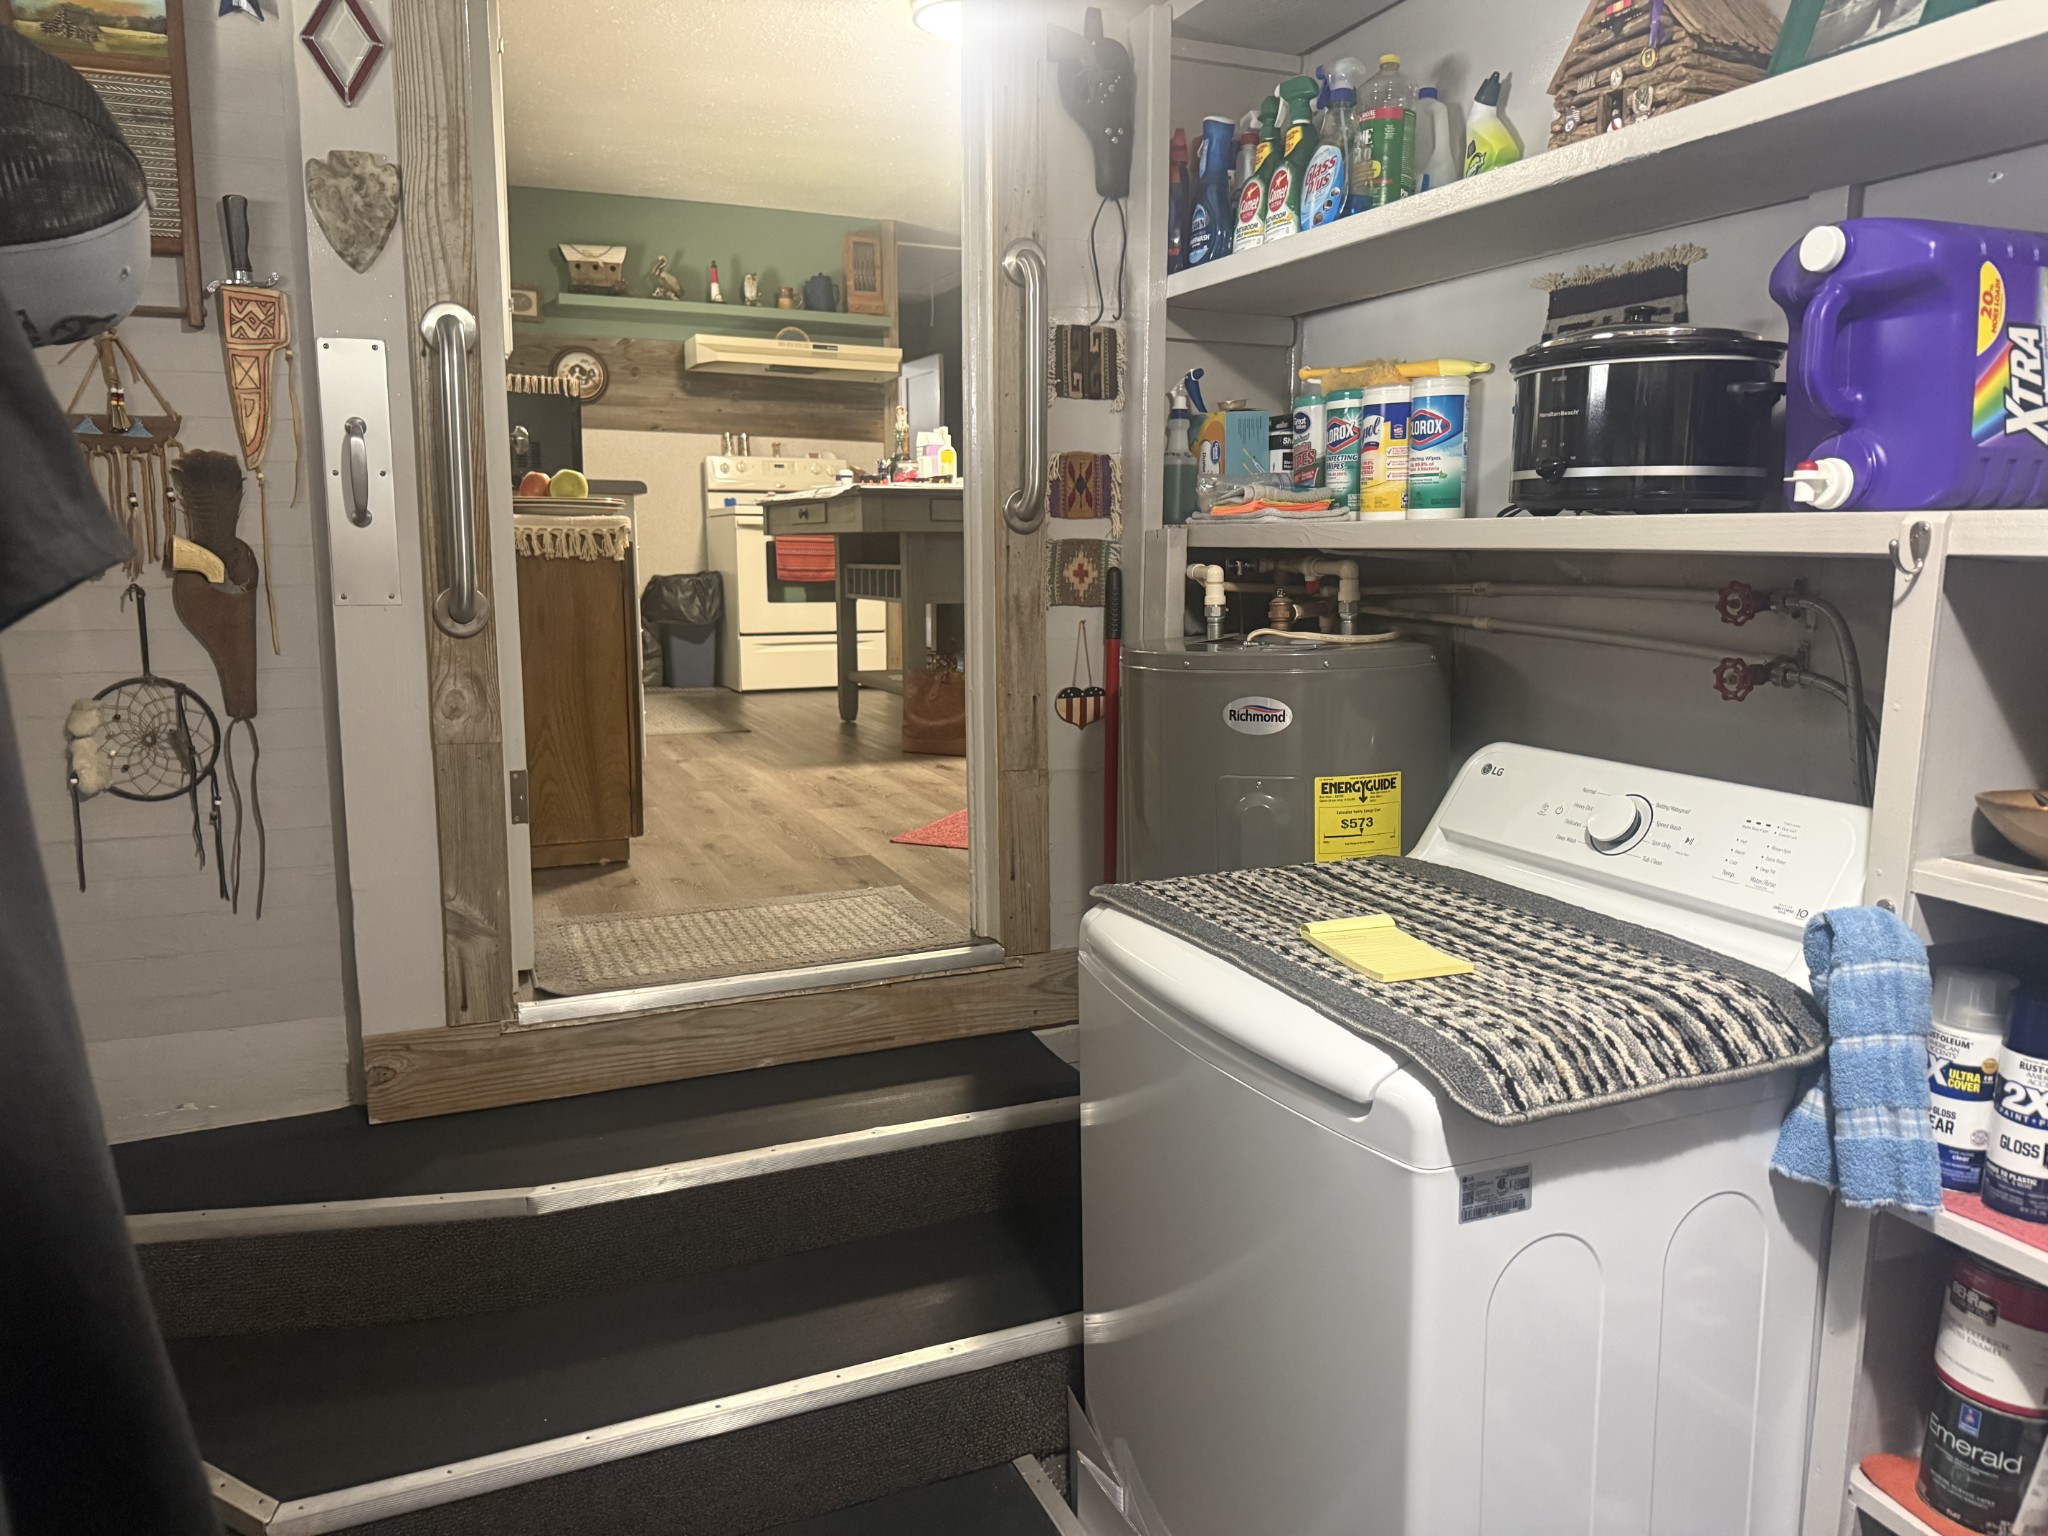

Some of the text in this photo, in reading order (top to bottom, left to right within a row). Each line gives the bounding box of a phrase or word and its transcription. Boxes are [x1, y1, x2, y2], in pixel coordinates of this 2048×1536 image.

[1305, 155, 1338, 187] Glass
[1270, 185, 1288, 202] Comet
[1241, 197, 1260, 213] Comet
[1991, 310, 1999, 333] MORE
[2004, 323, 2048, 447] XTRA
[1329, 423, 1356, 443] OROX
[1362, 417, 1380, 443] ysol
[1411, 419, 1443, 436] LOROX
[1294, 450, 1316, 470] IPES
[1229, 709, 1286, 723] Richmond
[1491, 766, 1505, 777] LG
[1321, 777, 1397, 796] ENERGYGUIDE
[1573, 802, 1586, 810] Heavy
[1340, 817, 1374, 830] $573
[1656, 820, 1670, 829] Speed
[1556, 833, 1567, 841] Deep
[1651, 839, 1672, 850] Spin Only
[1650, 858, 1663, 866] Clean
[1930, 1039, 1960, 1054] MERICAN
[1930, 1045, 1958, 1059] CCENTS
[1928, 1052, 1953, 1088] X
[1949, 1068, 1981, 1084] ULTRA
[2019, 1061, 2048, 1076] RUST-O
[2026, 1071, 2048, 1083] AMER
[1947, 1078, 1981, 1094] COVER
[2001, 1081, 2048, 1119] 2X
[1929, 1105, 1957, 1120] -GLOSS
[1929, 1114, 1955, 1136] EAR
[2000, 1133, 2041, 1159] GLOSS
[1951, 1154, 1970, 1163] clear
[2009, 1172, 2038, 1187] PLASTIC
[1952, 1280, 1980, 1308] BEHR
[1929, 1411, 2023, 1475] Emerald
